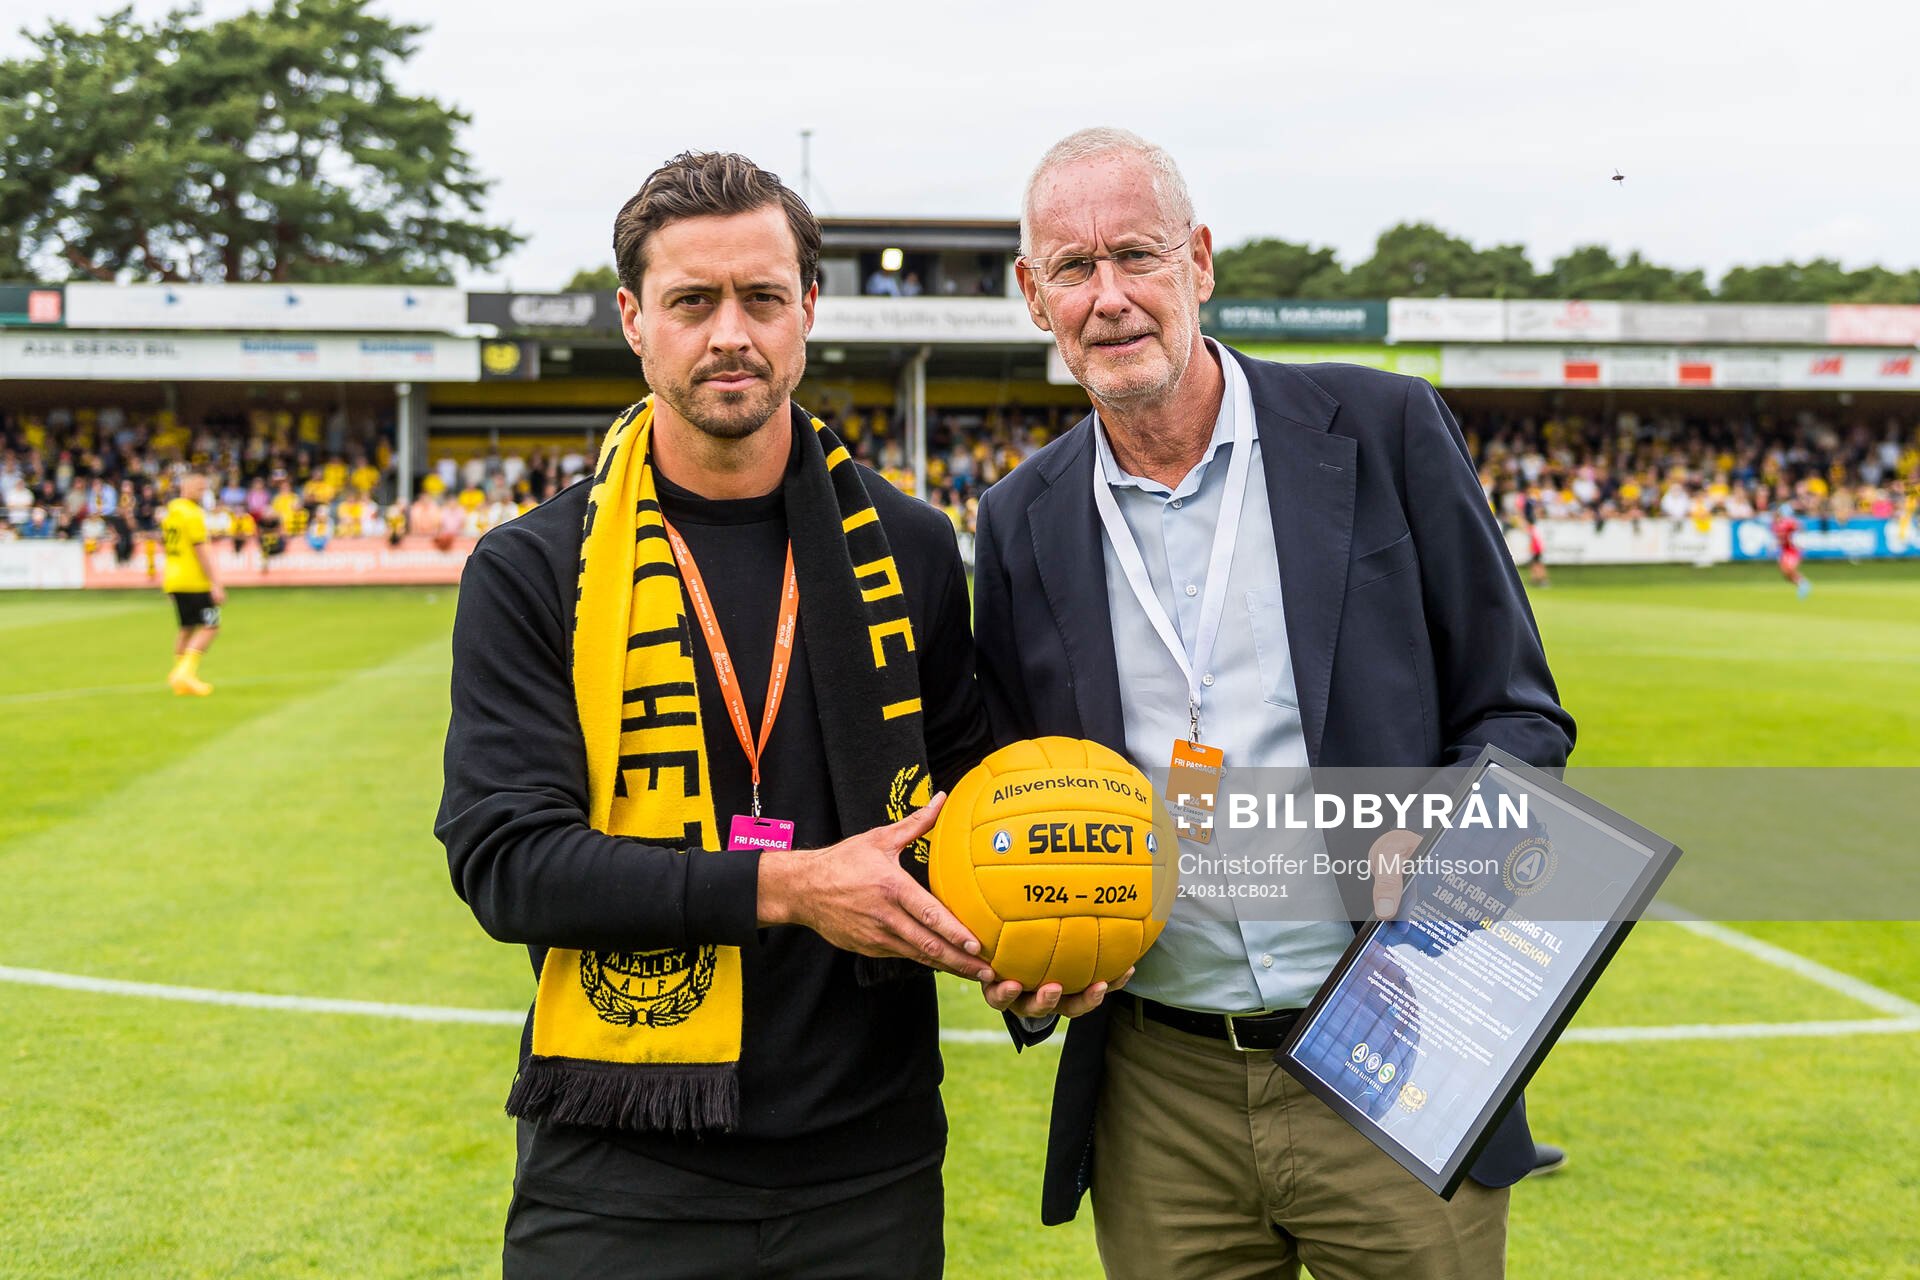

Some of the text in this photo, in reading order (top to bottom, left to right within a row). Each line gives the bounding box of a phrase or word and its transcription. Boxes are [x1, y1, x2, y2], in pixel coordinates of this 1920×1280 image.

[1174, 757, 1217, 775] FRI PASSAGE
[993, 775, 1148, 805] Allsvenskan 100 år
[734, 836, 788, 849] FRI PASSAGE
[1028, 823, 1134, 855] SELECT
[1024, 884, 1069, 904] 1924
[1094, 884, 1137, 904] 2024
[1441, 870, 1562, 953] TACK FÖR ERT BIDRAG TILL
[1432, 885, 1453, 904] 100
[1451, 896, 1467, 913] ÅR
[1480, 917, 1553, 966] ALLSVENSKAN
[605, 952, 686, 976] MJÄLLBY
